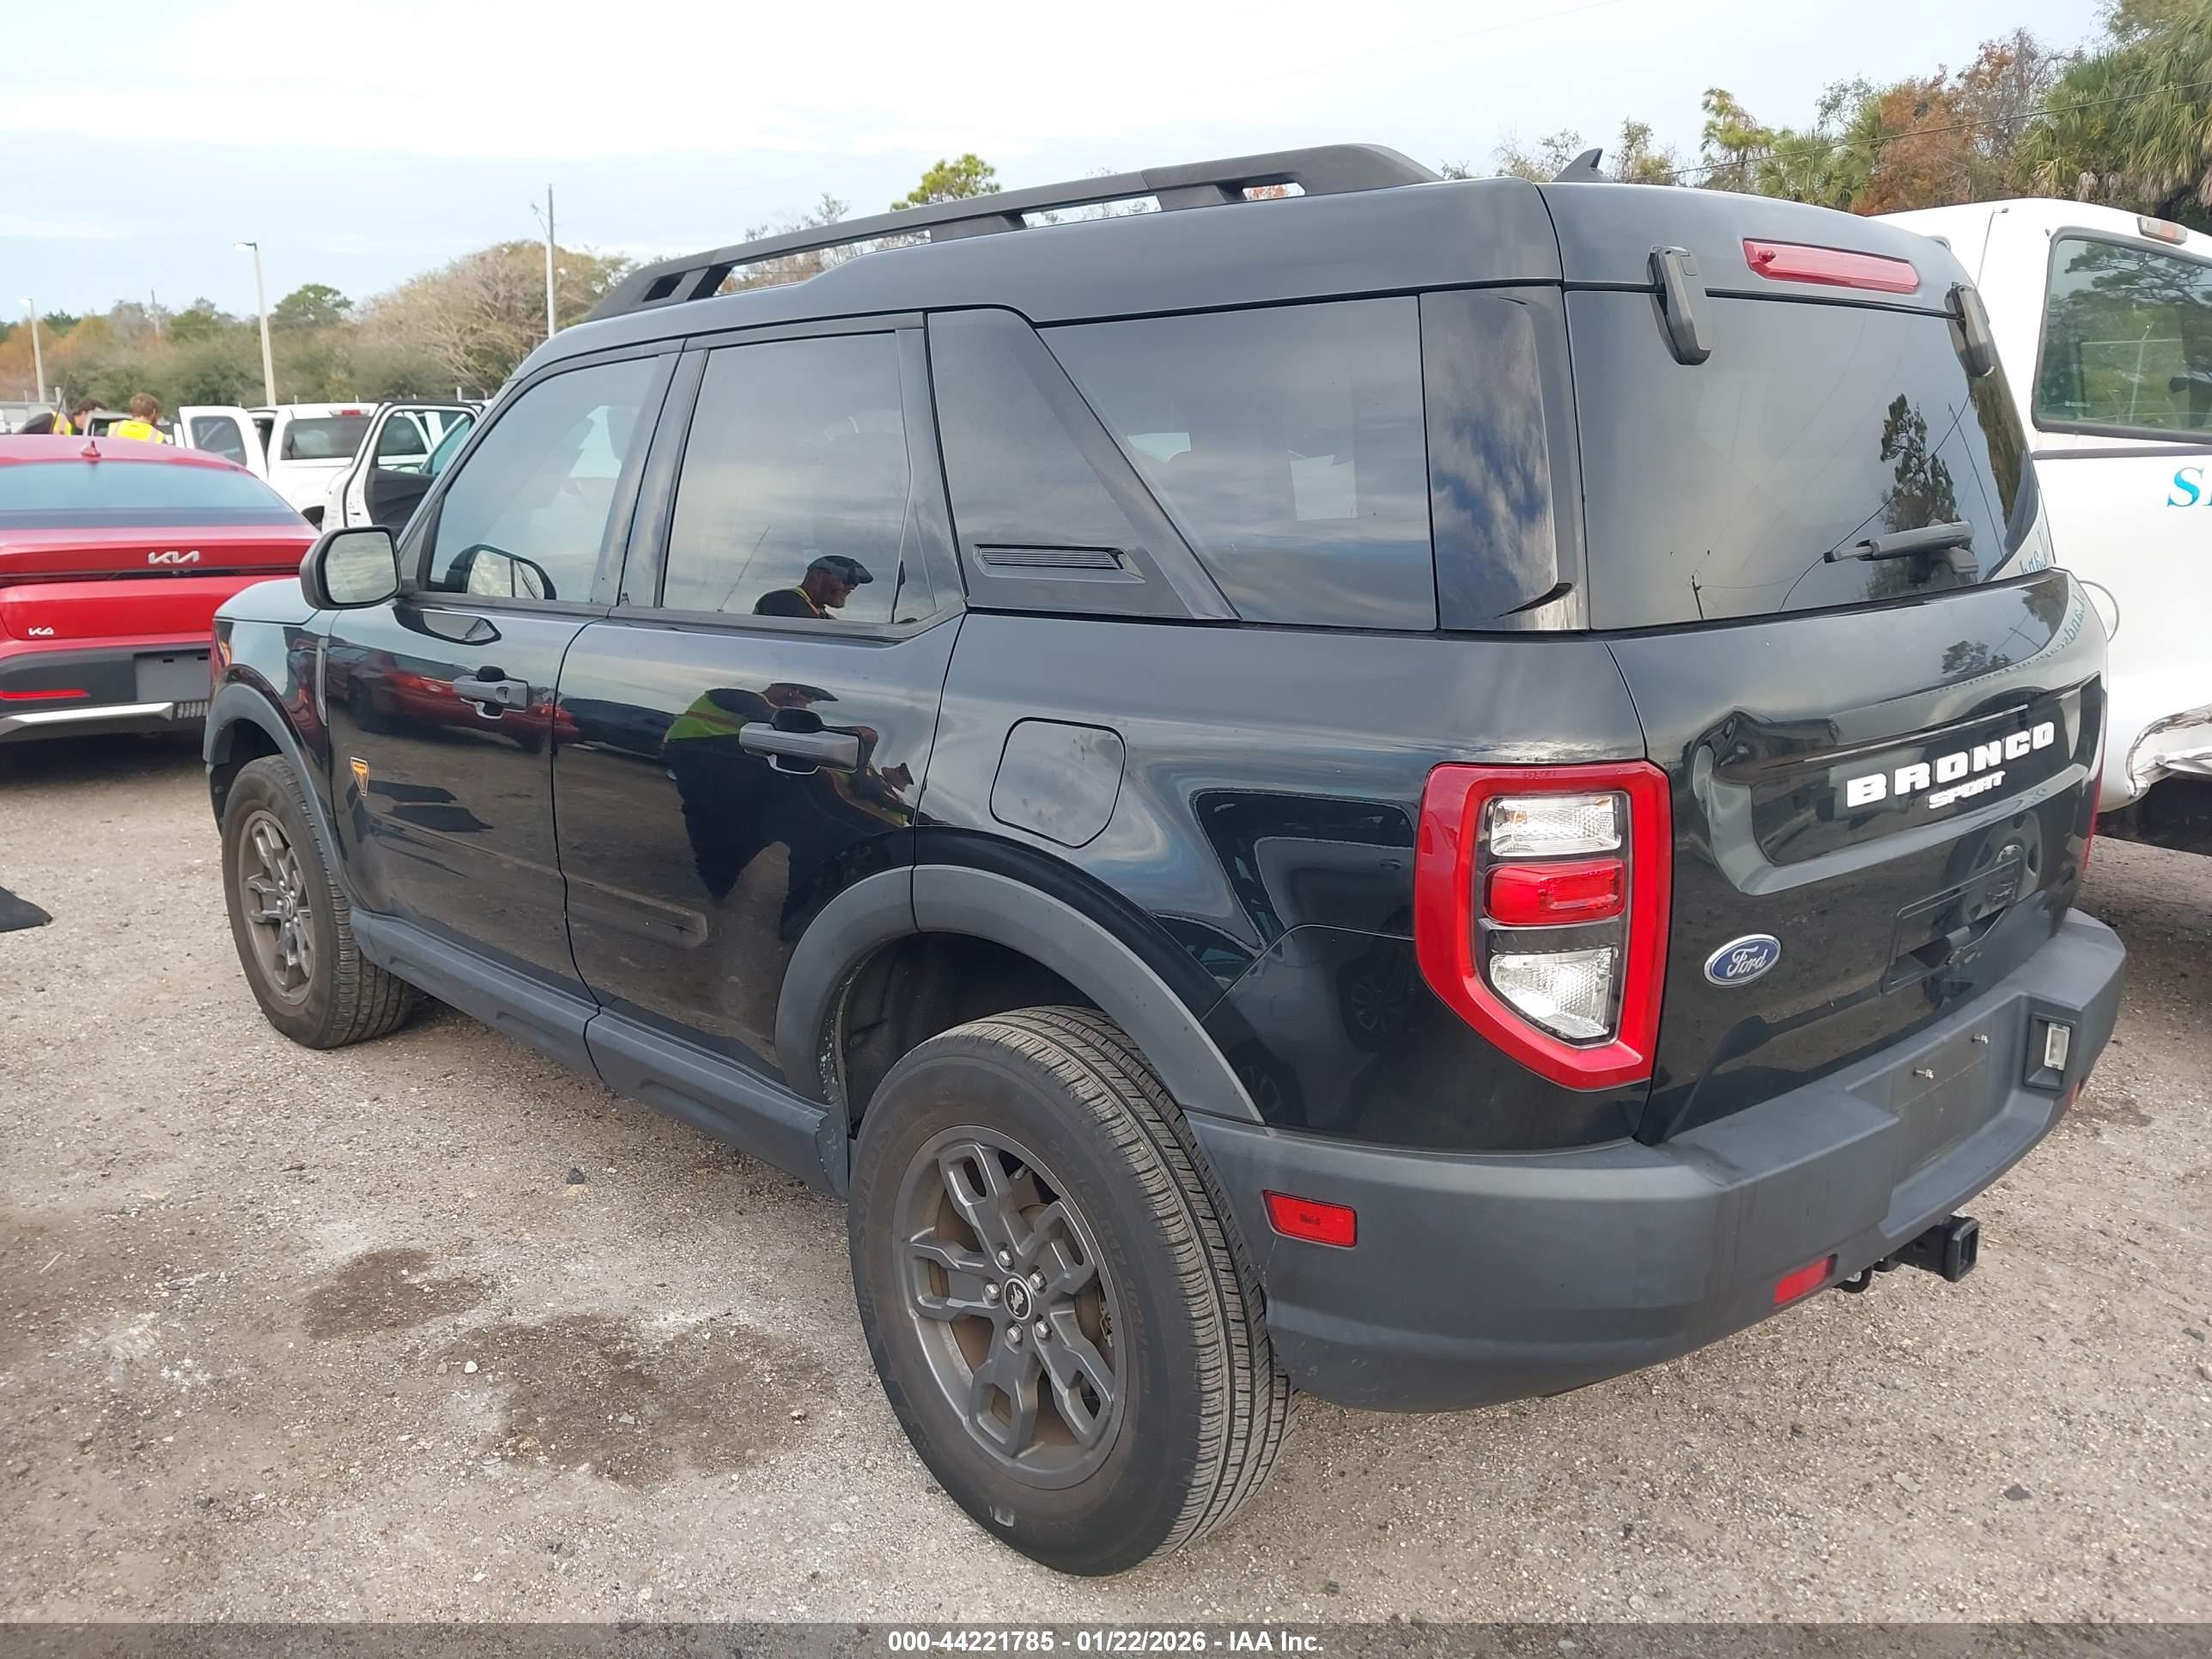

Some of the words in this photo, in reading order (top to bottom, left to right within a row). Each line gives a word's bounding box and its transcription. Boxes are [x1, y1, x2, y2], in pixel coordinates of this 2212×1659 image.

[2166, 466, 2212, 507] S
[148, 550, 199, 564] KIA
[27, 626, 55, 636] K4
[1846, 721, 2055, 808] BRONCO
[1927, 770, 2007, 809] SPORT
[1726, 945, 1769, 977] Ford
